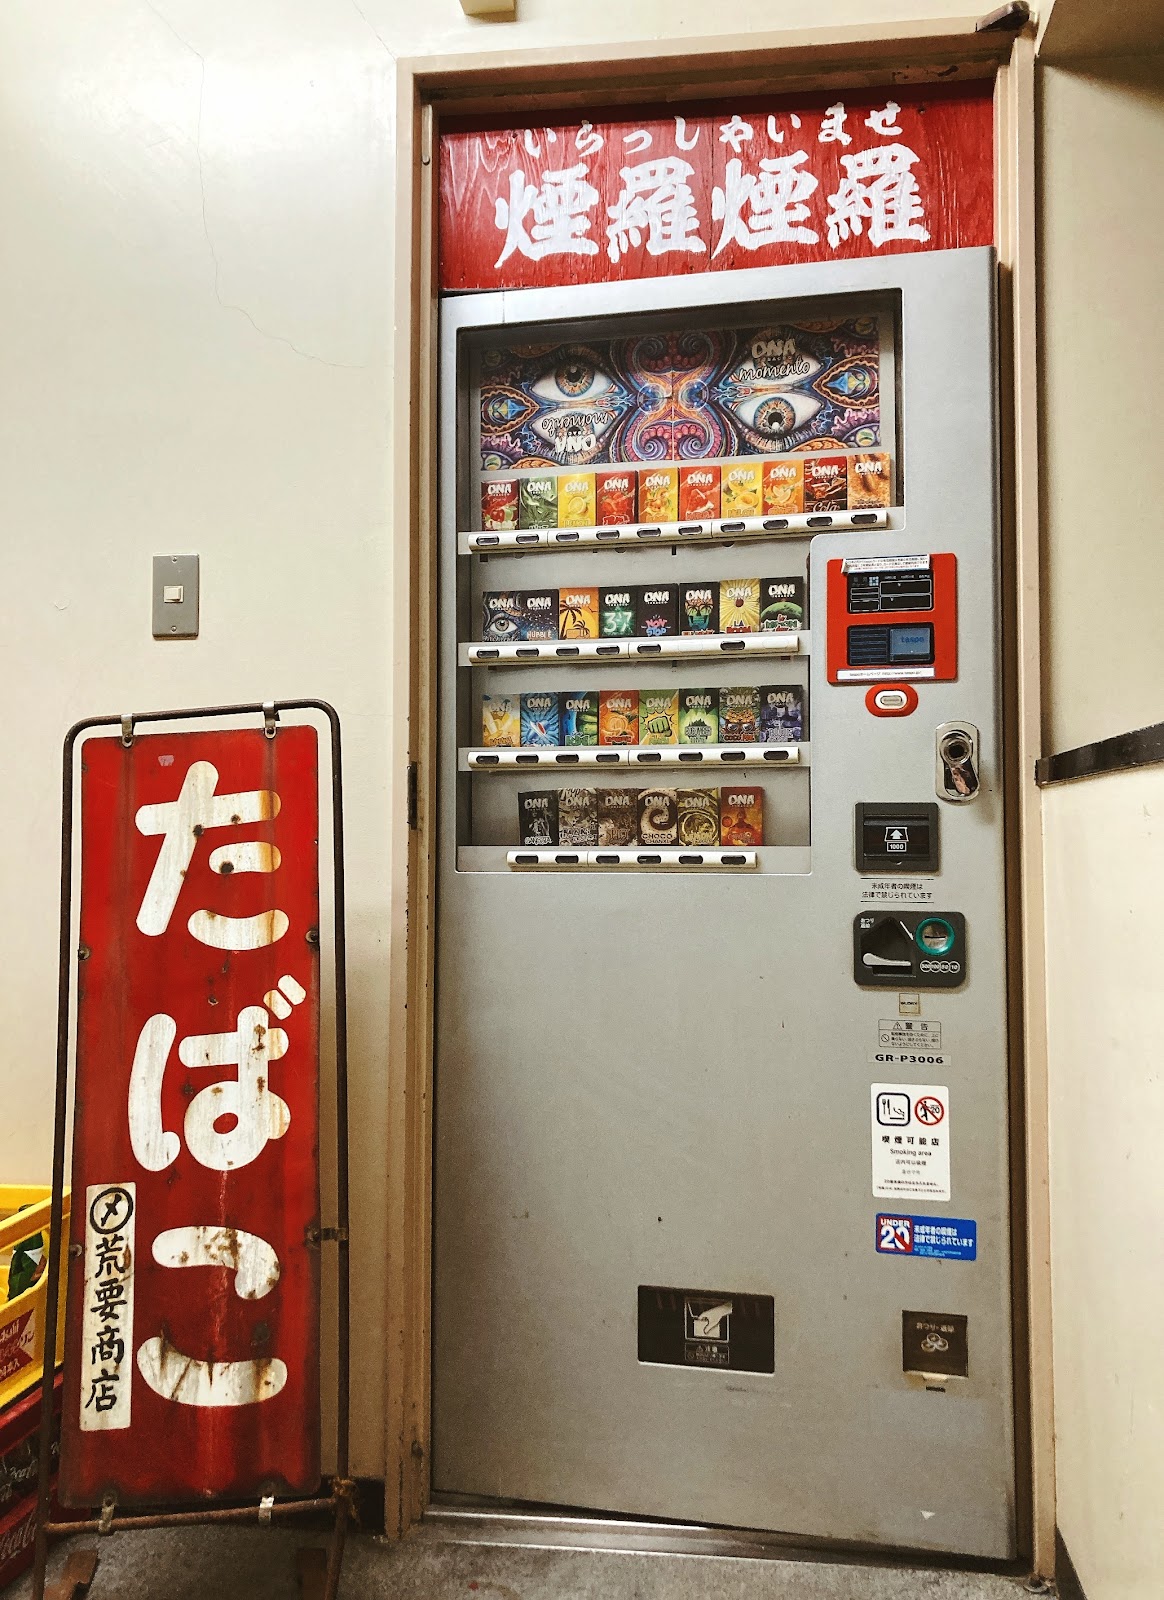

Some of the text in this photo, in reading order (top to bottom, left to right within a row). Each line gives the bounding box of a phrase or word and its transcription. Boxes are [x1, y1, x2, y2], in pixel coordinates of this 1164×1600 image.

[494, 142, 931, 269] 煙羅煙羅
[739, 354, 810, 381] momento
[874, 1053, 944, 1064] GR-P3006
[128, 760, 307, 1407] たばこ
[889, 1148, 917, 1157] Smoking
[880, 1217, 911, 1229] UNDER
[880, 1224, 910, 1251] 20
